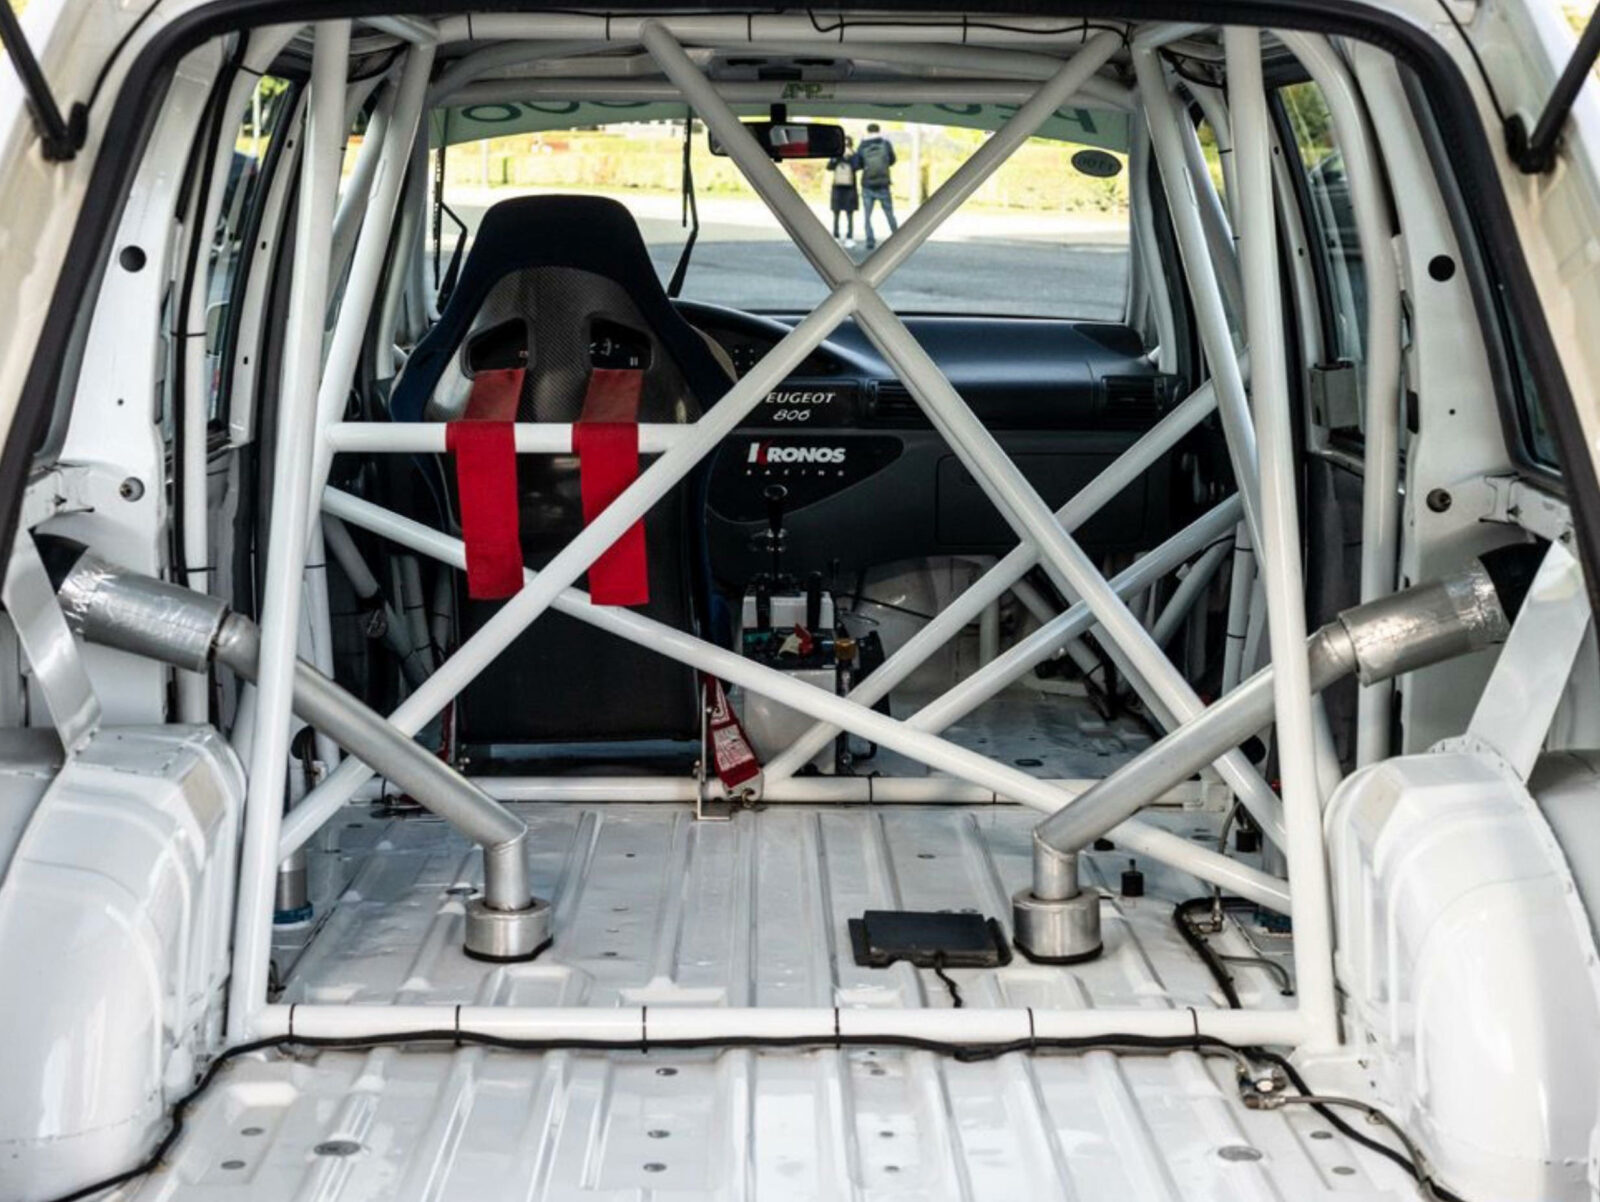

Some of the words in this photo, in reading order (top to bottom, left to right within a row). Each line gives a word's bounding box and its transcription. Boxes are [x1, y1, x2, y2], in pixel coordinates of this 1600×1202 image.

[765, 391, 836, 404] EUGEOT
[773, 409, 811, 421] 806
[747, 441, 846, 464] KRONOS
